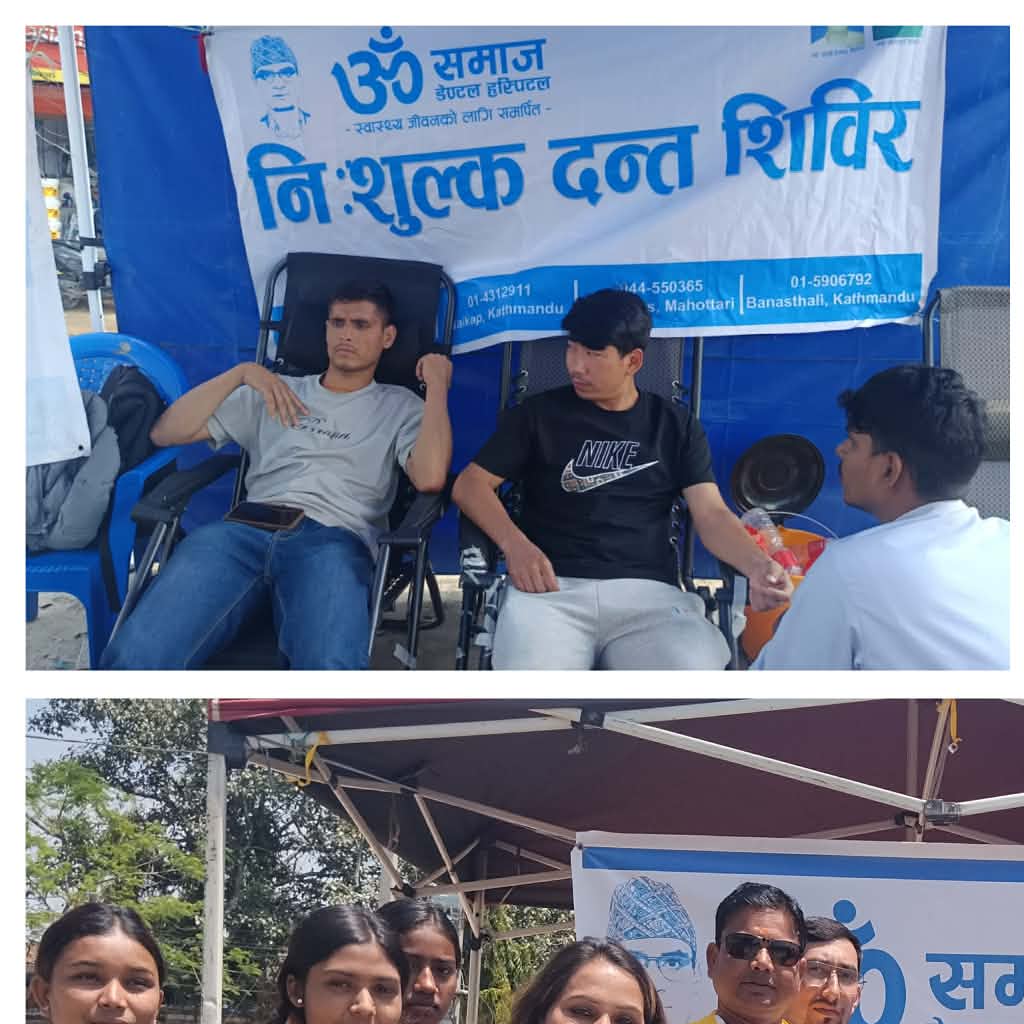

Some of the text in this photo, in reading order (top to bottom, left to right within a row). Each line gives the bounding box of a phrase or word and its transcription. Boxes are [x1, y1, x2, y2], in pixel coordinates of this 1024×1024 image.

[430, 39, 547, 81] समाज
[434, 76, 551, 102] डेण्टल हस्पिटल
[408, 108, 457, 130] जीवनको
[462, 106, 492, 124] लागि
[499, 99, 542, 120] समर्पित
[548, 125, 699, 207] दन्त
[721, 78, 920, 181] शिविर
[790, 272, 872, 290] 01-5906792
[467, 283, 531, 308] 01-4312911
[665, 297, 734, 314] Mahottari
[746, 289, 915, 311] Banasthali, Kathmandu
[487, 300, 564, 320] Kathmandu
[576, 440, 640, 470] NIKE
